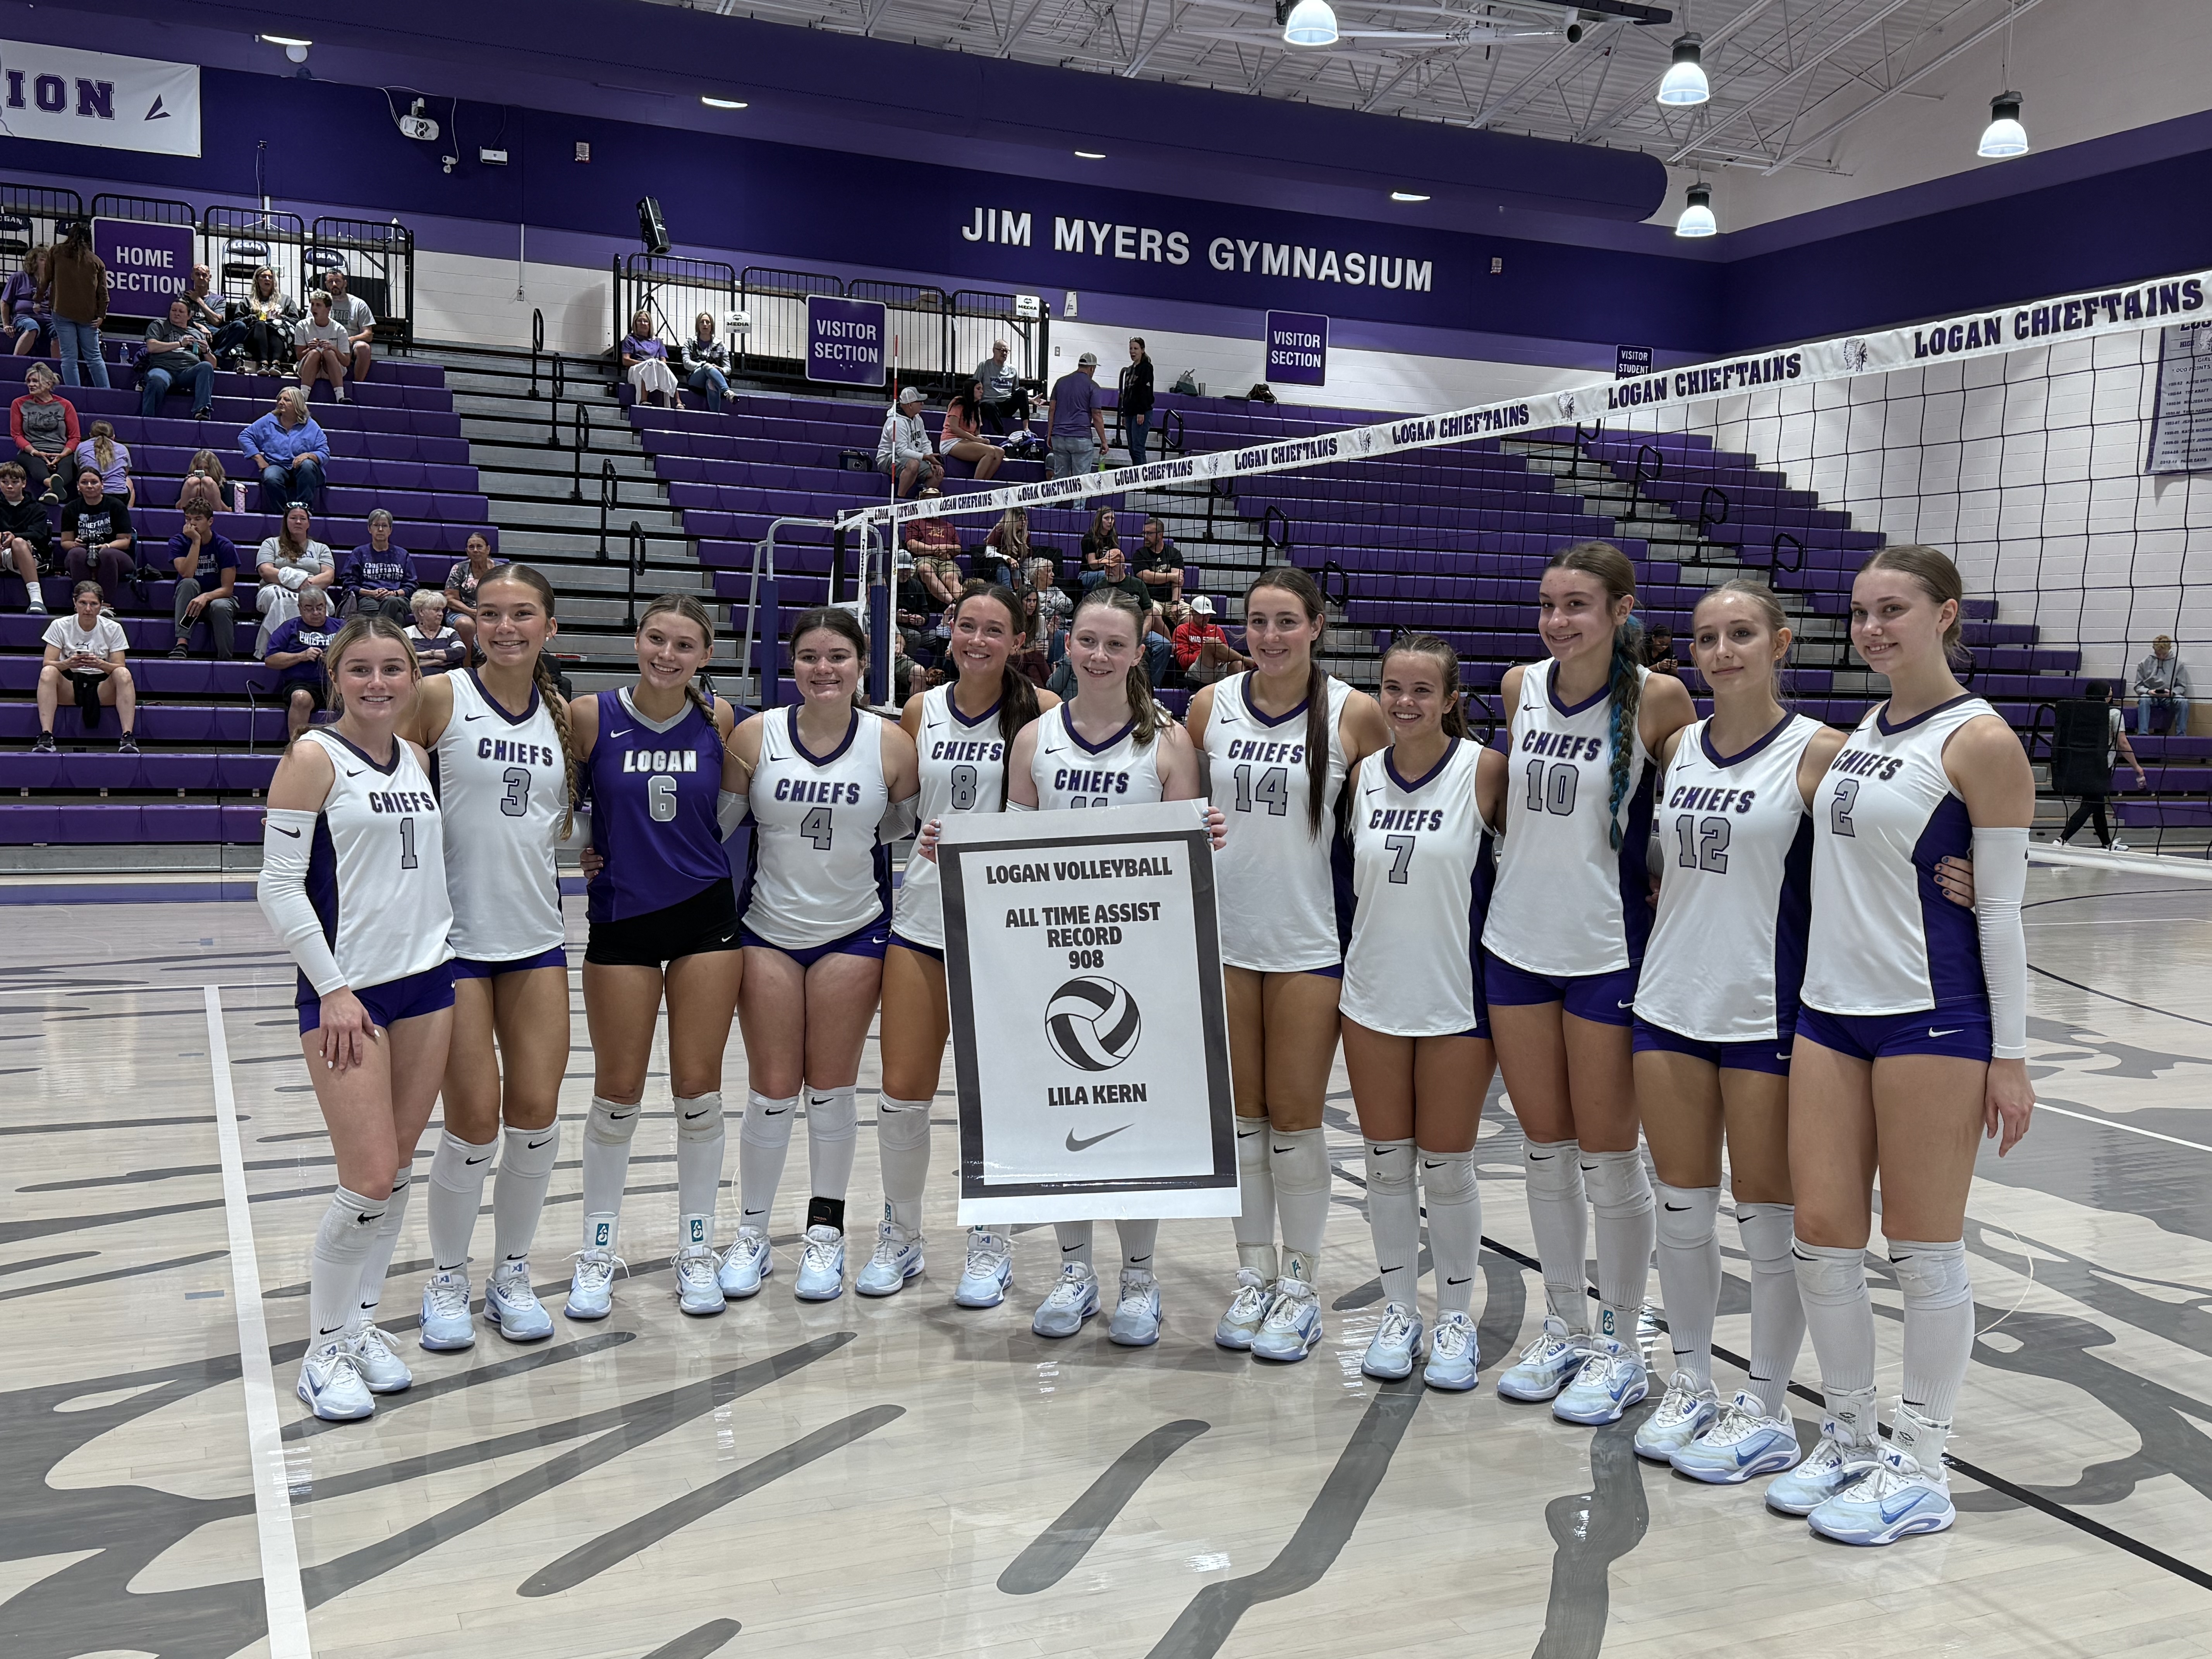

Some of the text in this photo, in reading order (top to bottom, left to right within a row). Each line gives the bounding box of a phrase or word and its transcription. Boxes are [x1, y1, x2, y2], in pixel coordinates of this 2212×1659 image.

[117, 246, 173, 268] HOME
[232, 240, 261, 251] LOGAN
[962, 207, 1433, 292] JIM MYERS GYMNASIUM
[106, 271, 185, 294] SECTION
[816, 319, 876, 340] VISITOR
[1915, 279, 2204, 359] LOGAN CHIEFTAINS
[1274, 330, 1320, 348] VISITOR
[814, 342, 878, 363] SECTION
[1271, 349, 1321, 368] SECTION
[1621, 350, 1648, 361] VISITOR
[1608, 352, 1802, 410] LOGAN CHIEFTAINS
[1619, 363, 1649, 374] STUDENT
[1393, 403, 1529, 445] LOGAN CHIEFTAINS
[1234, 438, 1338, 470] LOGAN CHIEFTAINS
[1115, 460, 1193, 486] LOGAN CHIEFTAINS
[939, 493, 992, 512] LOGAN CHIEFTAINS
[1018, 477, 1082, 502] LOGAN CHIEFTAINS
[78, 517, 110, 529] CHIEFTAIN
[477, 737, 554, 767] CHIEFS
[931, 741, 1003, 761] CHIEFS
[1227, 739, 1305, 764] CHIEFS
[1521, 729, 1603, 763] CHIEFS
[623, 750, 697, 773] LOGAN
[1831, 749, 1905, 781] CHIEFS
[500, 766, 531, 817] 3
[774, 778, 861, 805] CHIEFS
[951, 765, 977, 810] 8
[1054, 768, 1130, 795] CHIEFS
[1233, 764, 1288, 816] 14
[1526, 759, 1579, 816] 10
[368, 791, 435, 814] CHIEFS
[647, 775, 677, 822] 6
[1669, 785, 1757, 815] CHIEFS
[1831, 778, 1859, 838] 2
[800, 807, 833, 851] 4
[1368, 809, 1444, 831] CHIEFS
[400, 817, 418, 869] 1
[1676, 814, 1731, 874] 12
[986, 857, 1173, 884] LOGAN VOLLEYBALL
[1384, 834, 1416, 884] 7
[1005, 902, 1161, 928] ALL TIME ASSIST
[1047, 926, 1122, 948] RECORD
[1068, 950, 1104, 969] 908
[1048, 1083, 1147, 1106] LILA KERN
